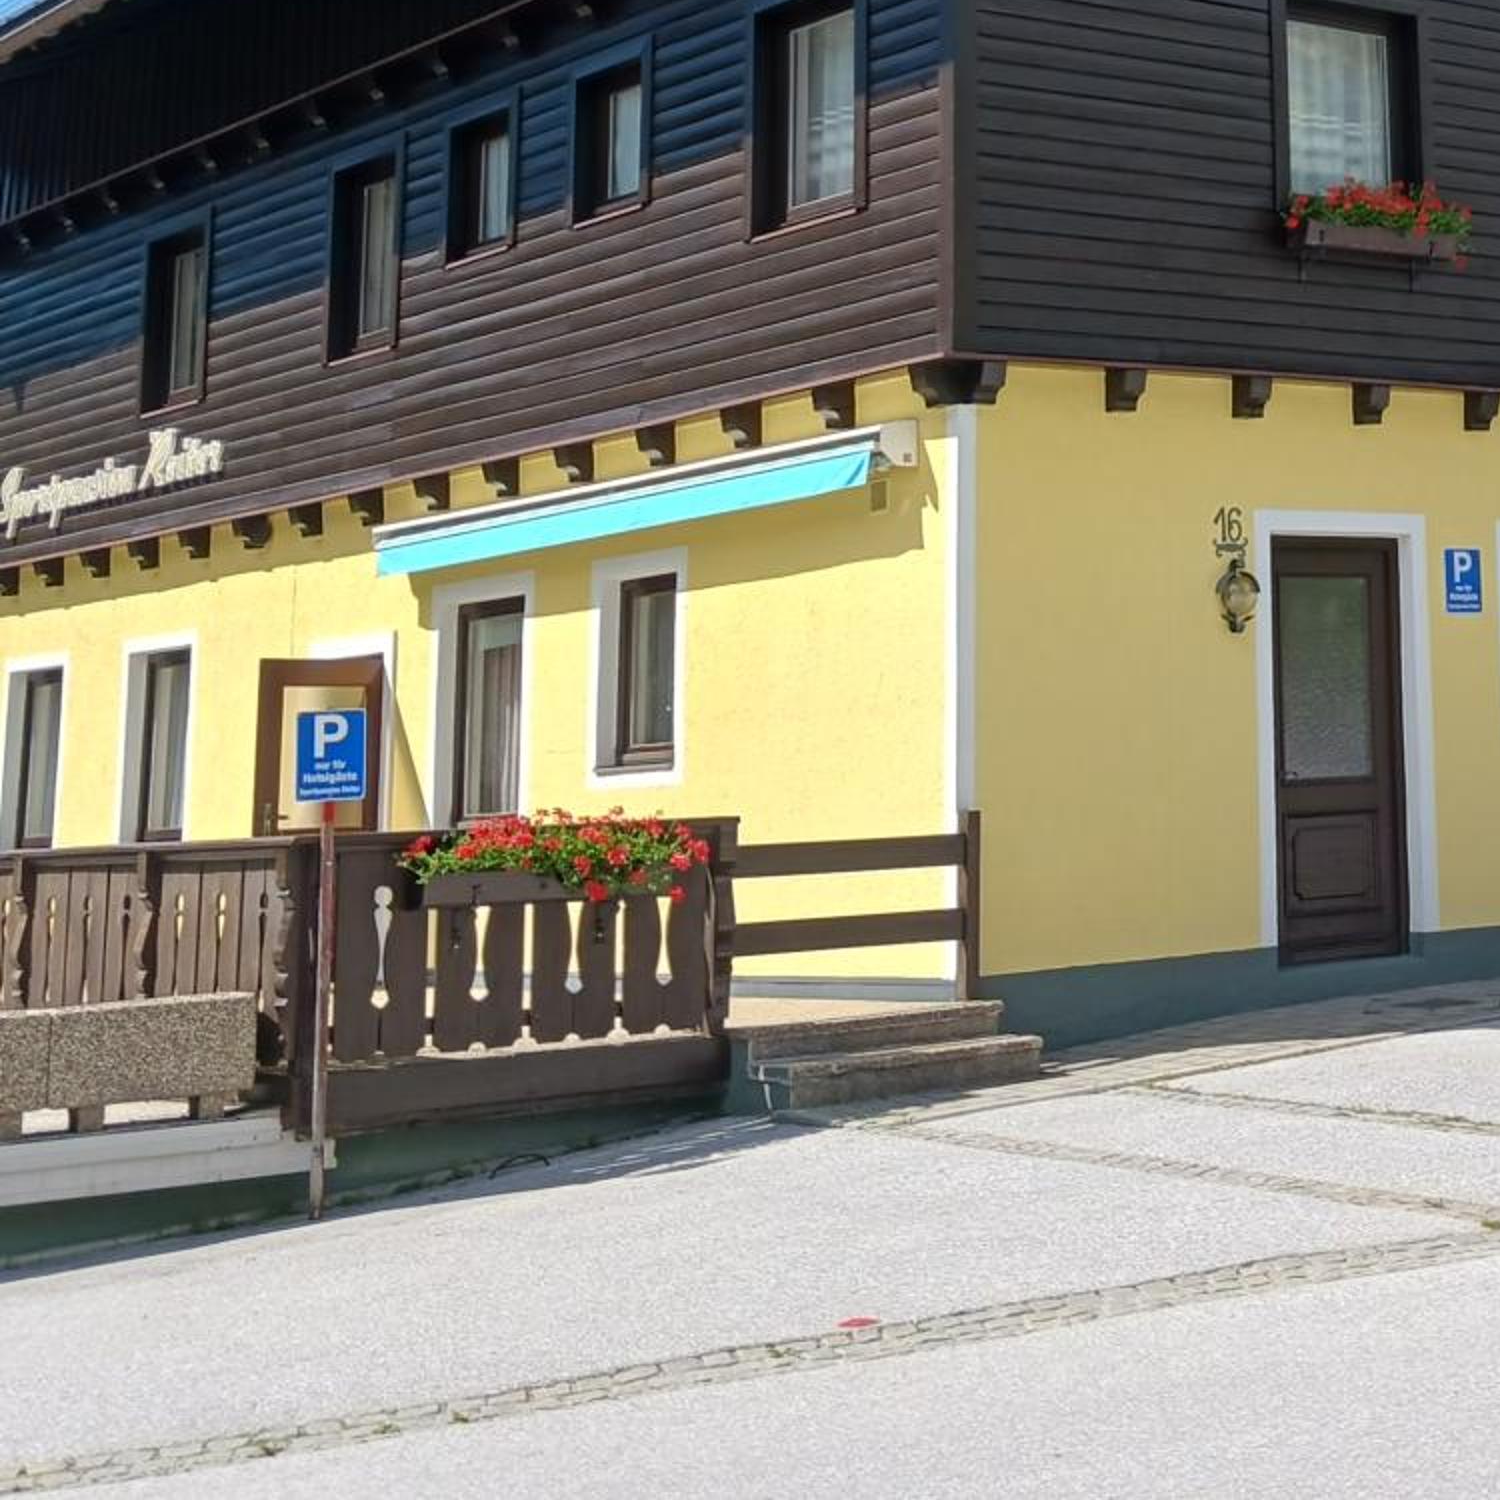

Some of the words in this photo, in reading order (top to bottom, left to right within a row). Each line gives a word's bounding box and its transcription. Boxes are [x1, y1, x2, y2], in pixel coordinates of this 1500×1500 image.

[138, 427, 225, 490] Reiter
[1213, 506, 1243, 542] 16
[1453, 551, 1473, 583] P
[313, 713, 349, 759] P
